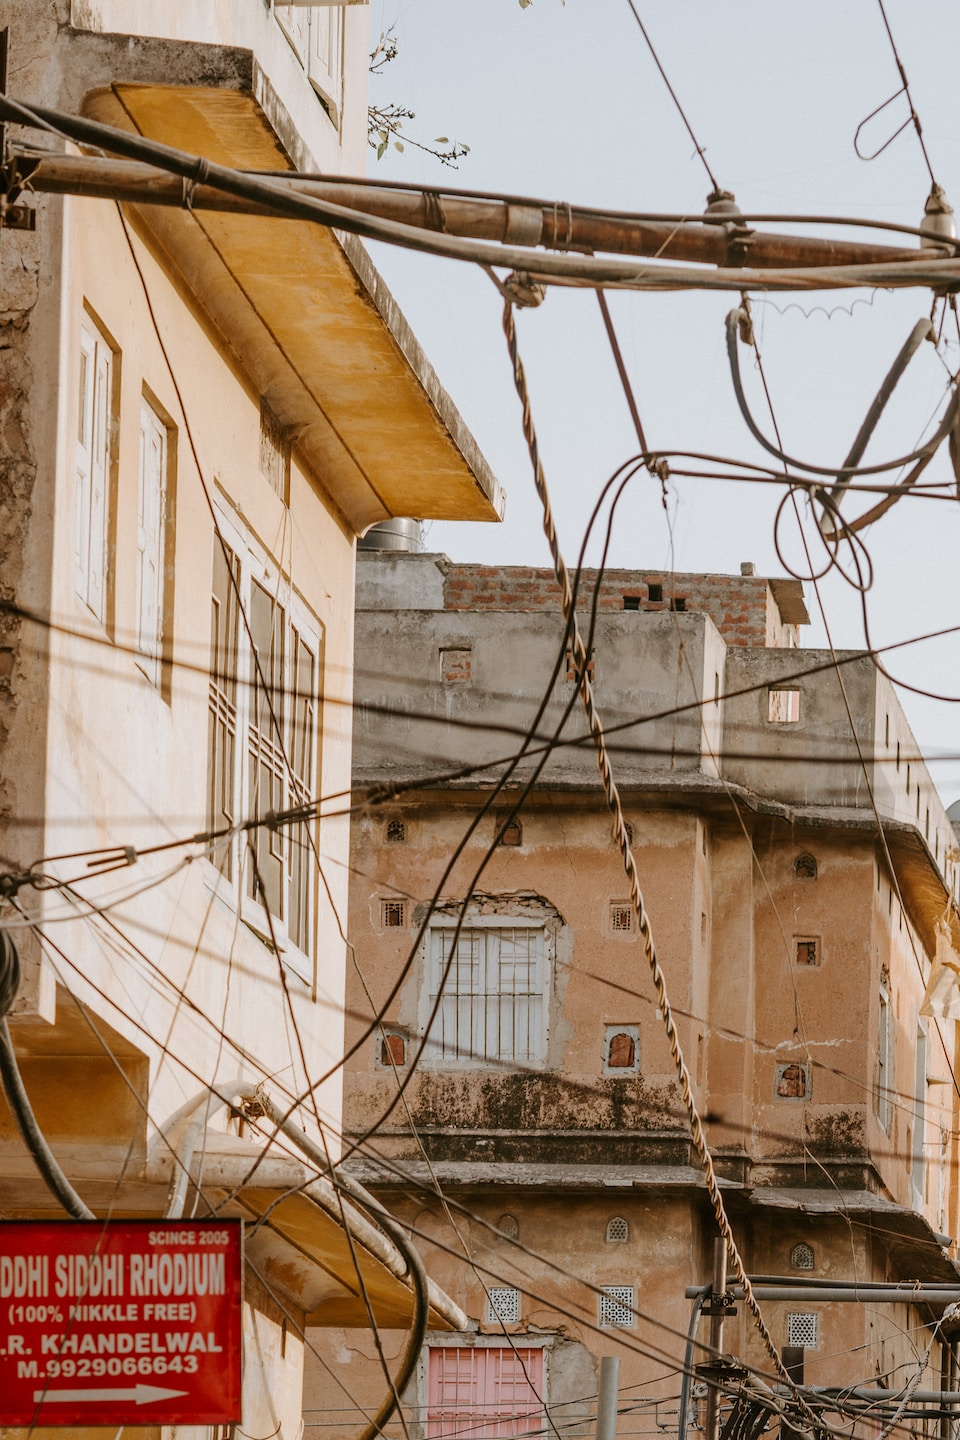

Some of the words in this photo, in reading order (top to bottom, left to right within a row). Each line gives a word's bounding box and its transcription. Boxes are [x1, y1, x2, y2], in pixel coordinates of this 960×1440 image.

[149, 1231, 195, 1245] SCINCE
[199, 1231, 229, 1245] 2005
[55, 1254, 124, 1297] SIDDHI
[130, 1253, 225, 1297] RHODIUM
[8, 1304, 64, 1325] (100%
[69, 1304, 138, 1322] NIKKLE
[143, 1302, 197, 1323] FREE)
[41, 1332, 222, 1354] KHANDELWAL
